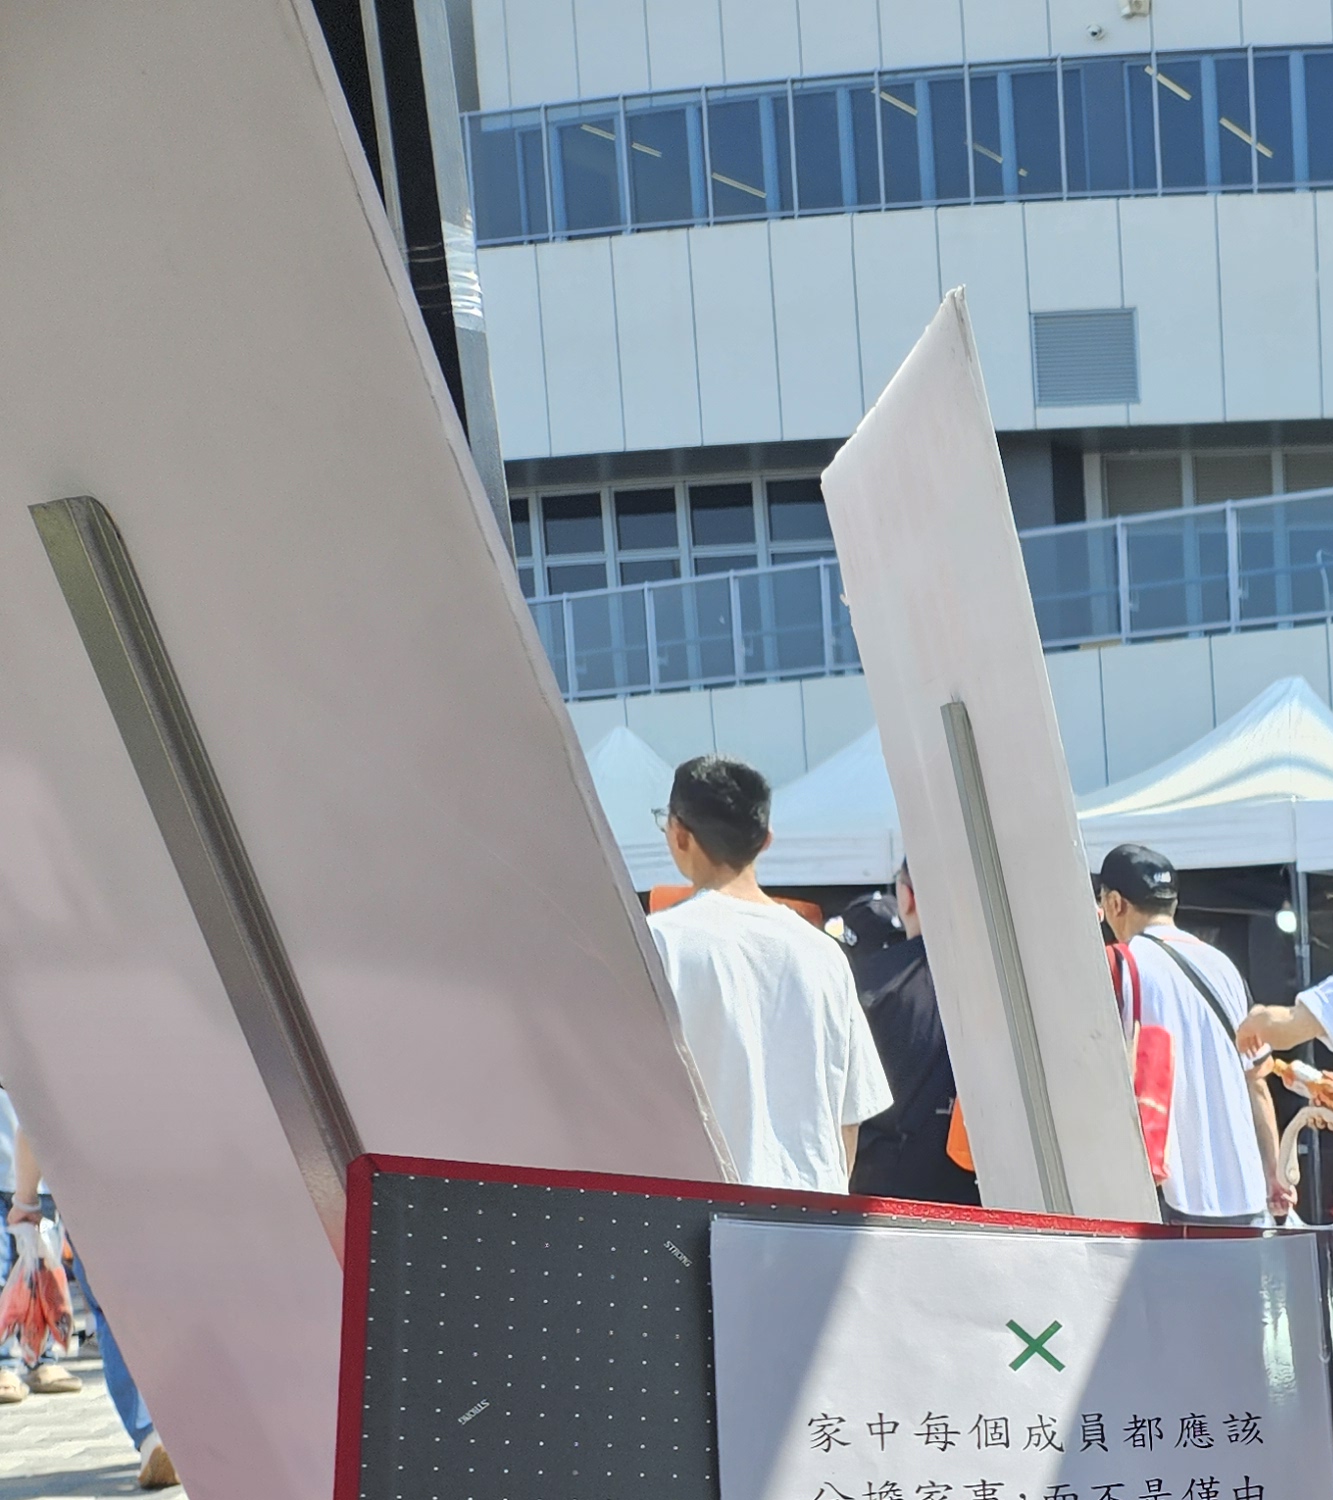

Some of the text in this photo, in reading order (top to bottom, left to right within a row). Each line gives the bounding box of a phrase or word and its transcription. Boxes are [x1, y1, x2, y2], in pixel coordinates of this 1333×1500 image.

[807, 1411, 1266, 1455] 家中每個成員都應該
